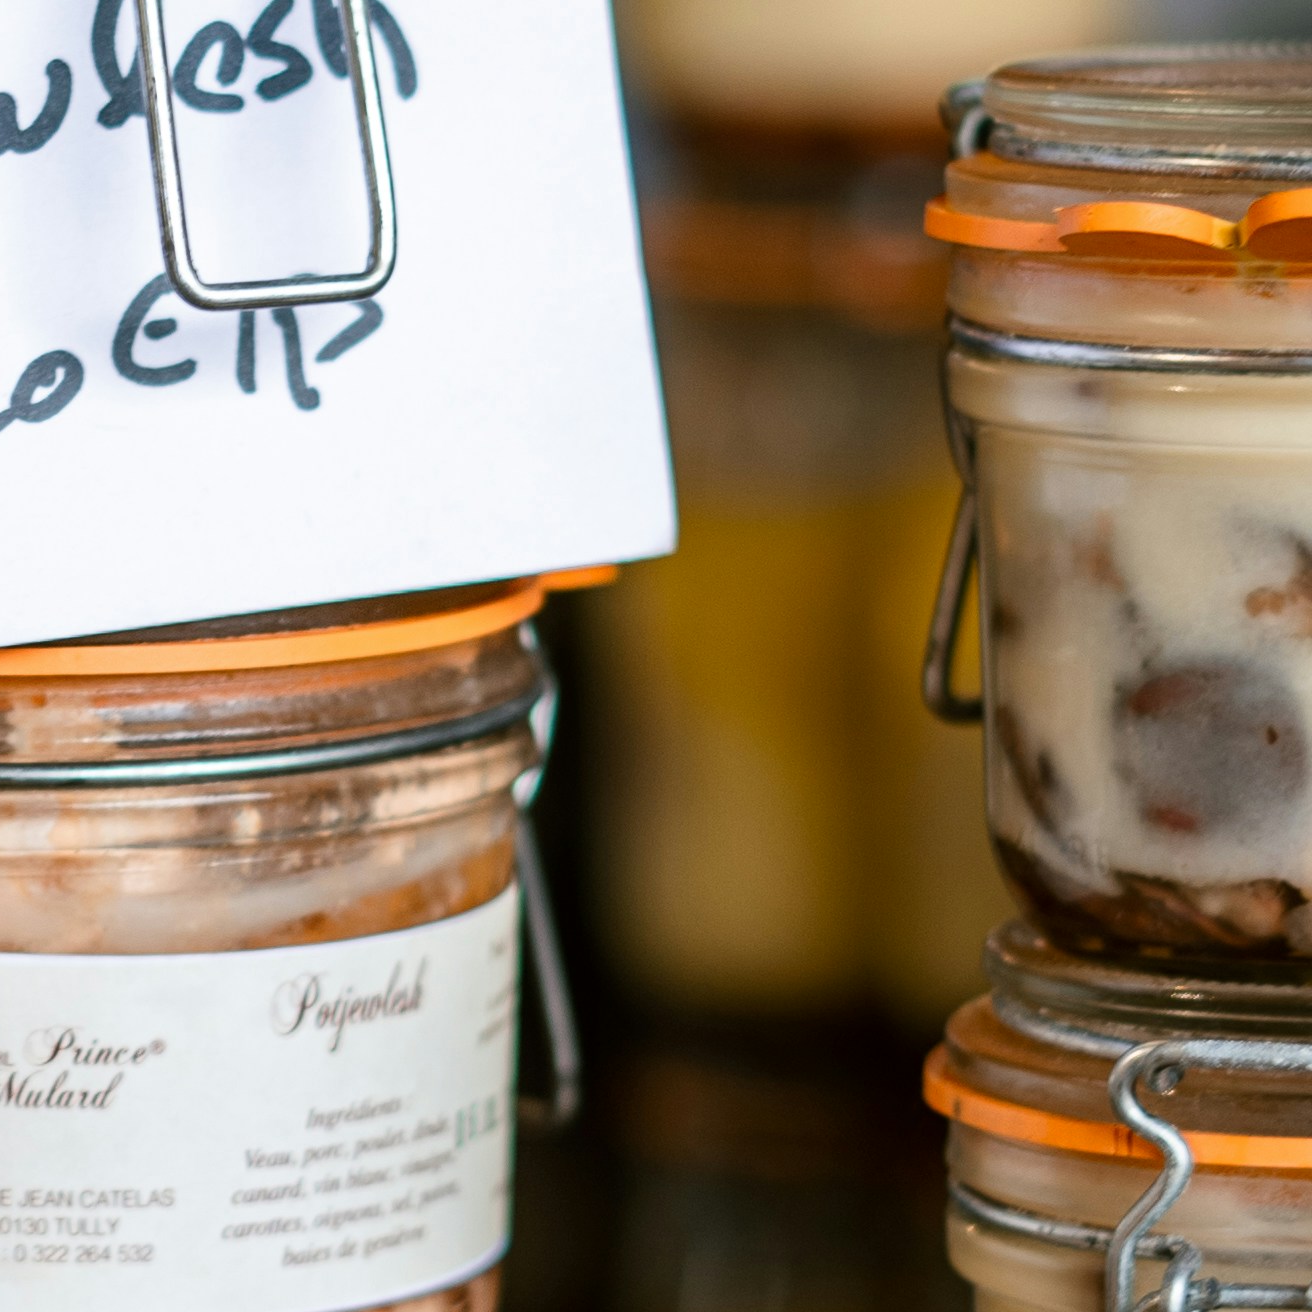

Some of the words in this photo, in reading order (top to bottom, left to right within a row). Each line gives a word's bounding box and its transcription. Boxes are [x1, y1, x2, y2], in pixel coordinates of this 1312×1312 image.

[17, 1188, 73, 1209] JEAN
[78, 1188, 177, 1210] CATELAS
[55, 1216, 121, 1237] TULLY
[32, 1244, 69, 1263] 322
[117, 1244, 155, 1263] 532
